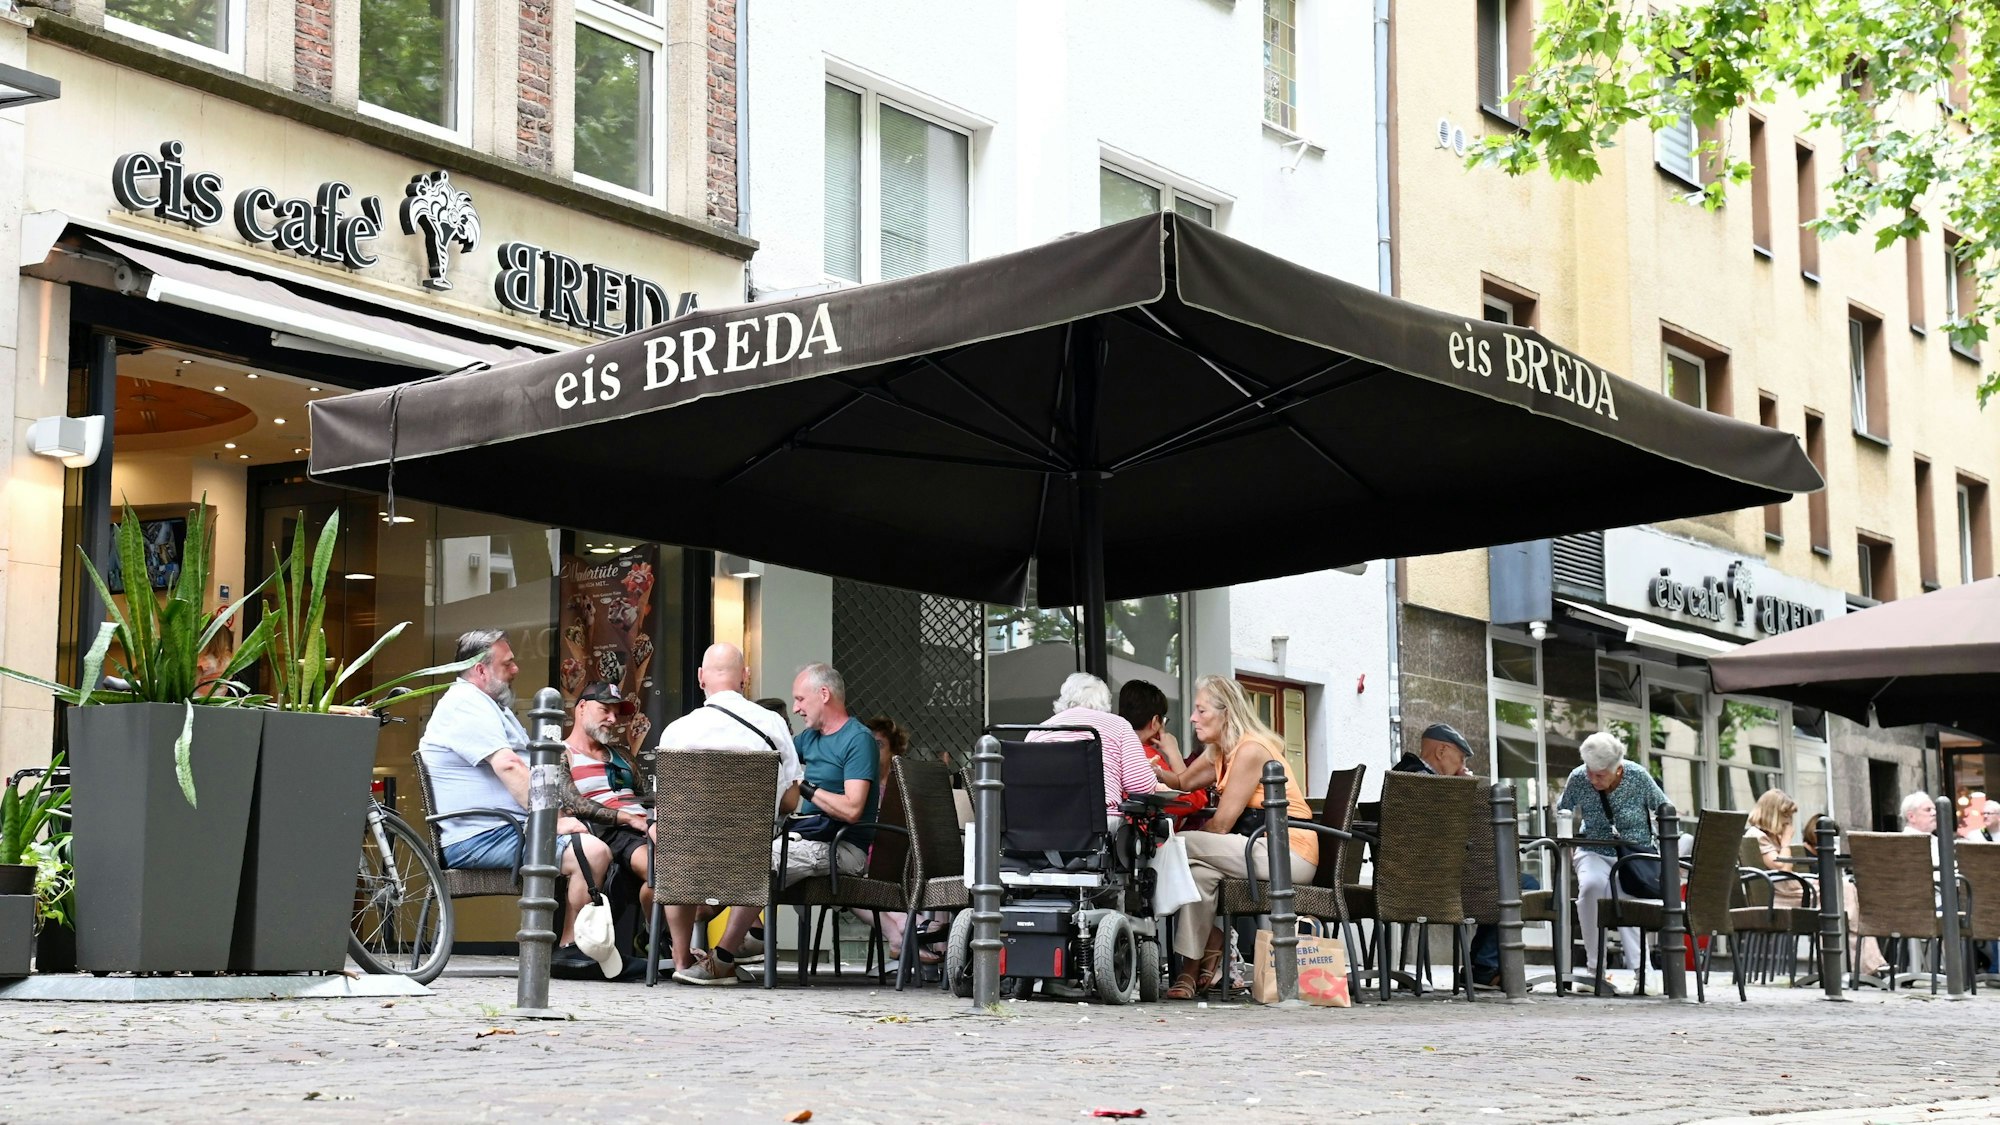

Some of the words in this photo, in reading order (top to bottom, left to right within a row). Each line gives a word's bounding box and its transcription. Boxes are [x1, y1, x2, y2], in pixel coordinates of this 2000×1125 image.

[113, 140, 224, 226] eis
[554, 353, 621, 410] eis
[643, 302, 842, 391] BREDA
[1448, 322, 1493, 377] eis
[1502, 332, 1619, 421] BREDA
[1648, 567, 1685, 611] eis
[1309, 956, 1334, 965] MEERE
